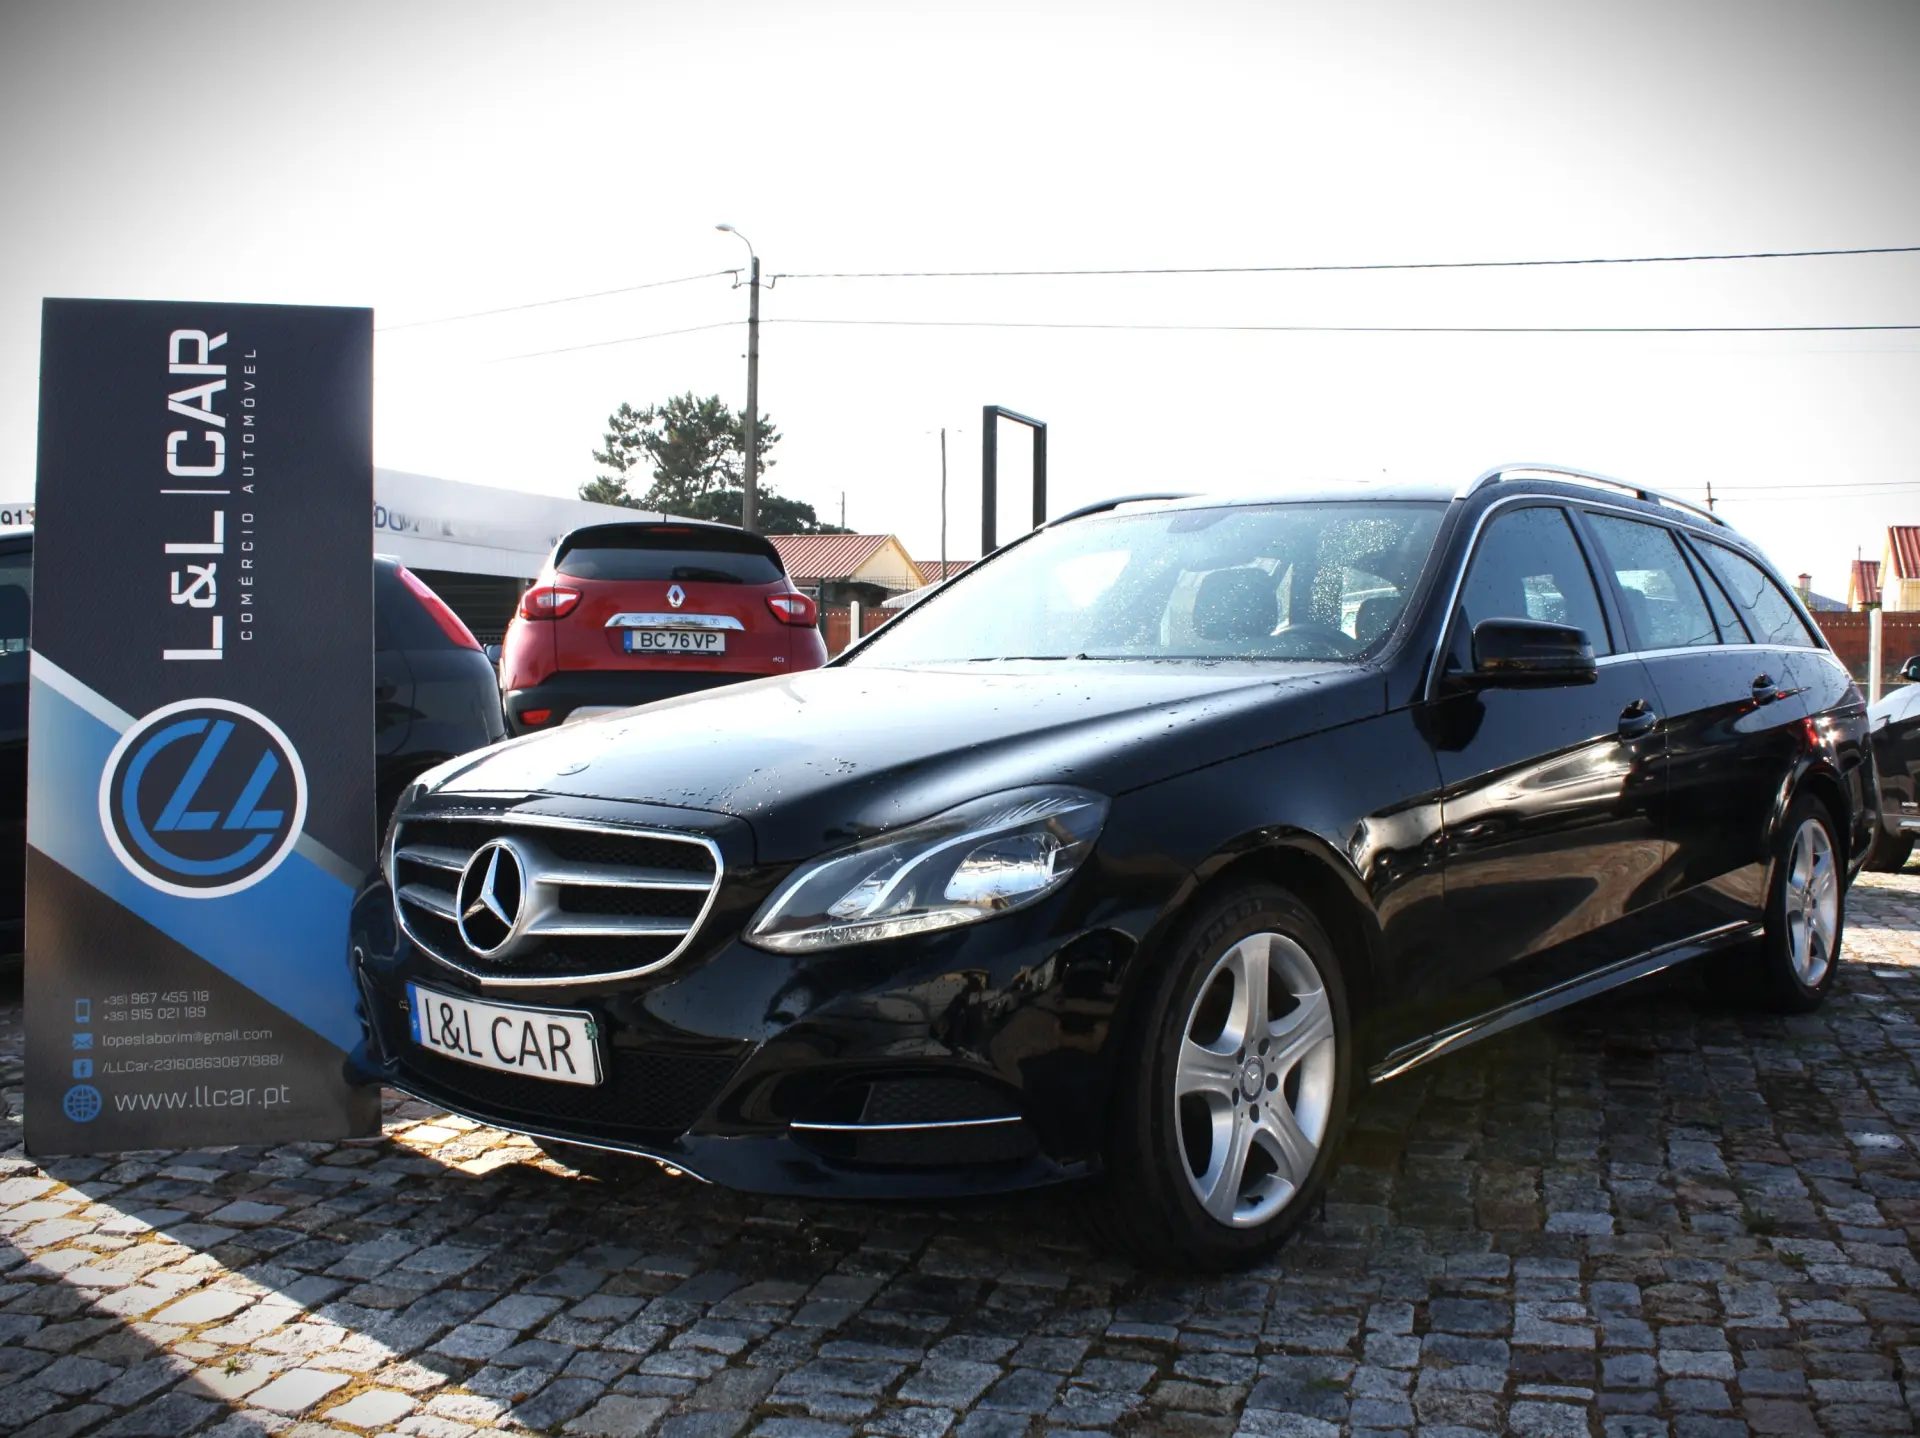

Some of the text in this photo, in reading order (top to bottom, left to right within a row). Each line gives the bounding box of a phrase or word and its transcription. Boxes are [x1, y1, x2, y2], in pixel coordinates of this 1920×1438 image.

[163, 329, 228, 660] L&L CAR
[238, 350, 257, 641] COMÉRCIO AUTOMÓVEL
[103, 990, 210, 1006] +351 967 455 118
[103, 1006, 207, 1021] +351 915 021 189
[424, 998, 576, 1075] L&L CAR
[114, 1084, 291, 1113] www.llcar.pt
